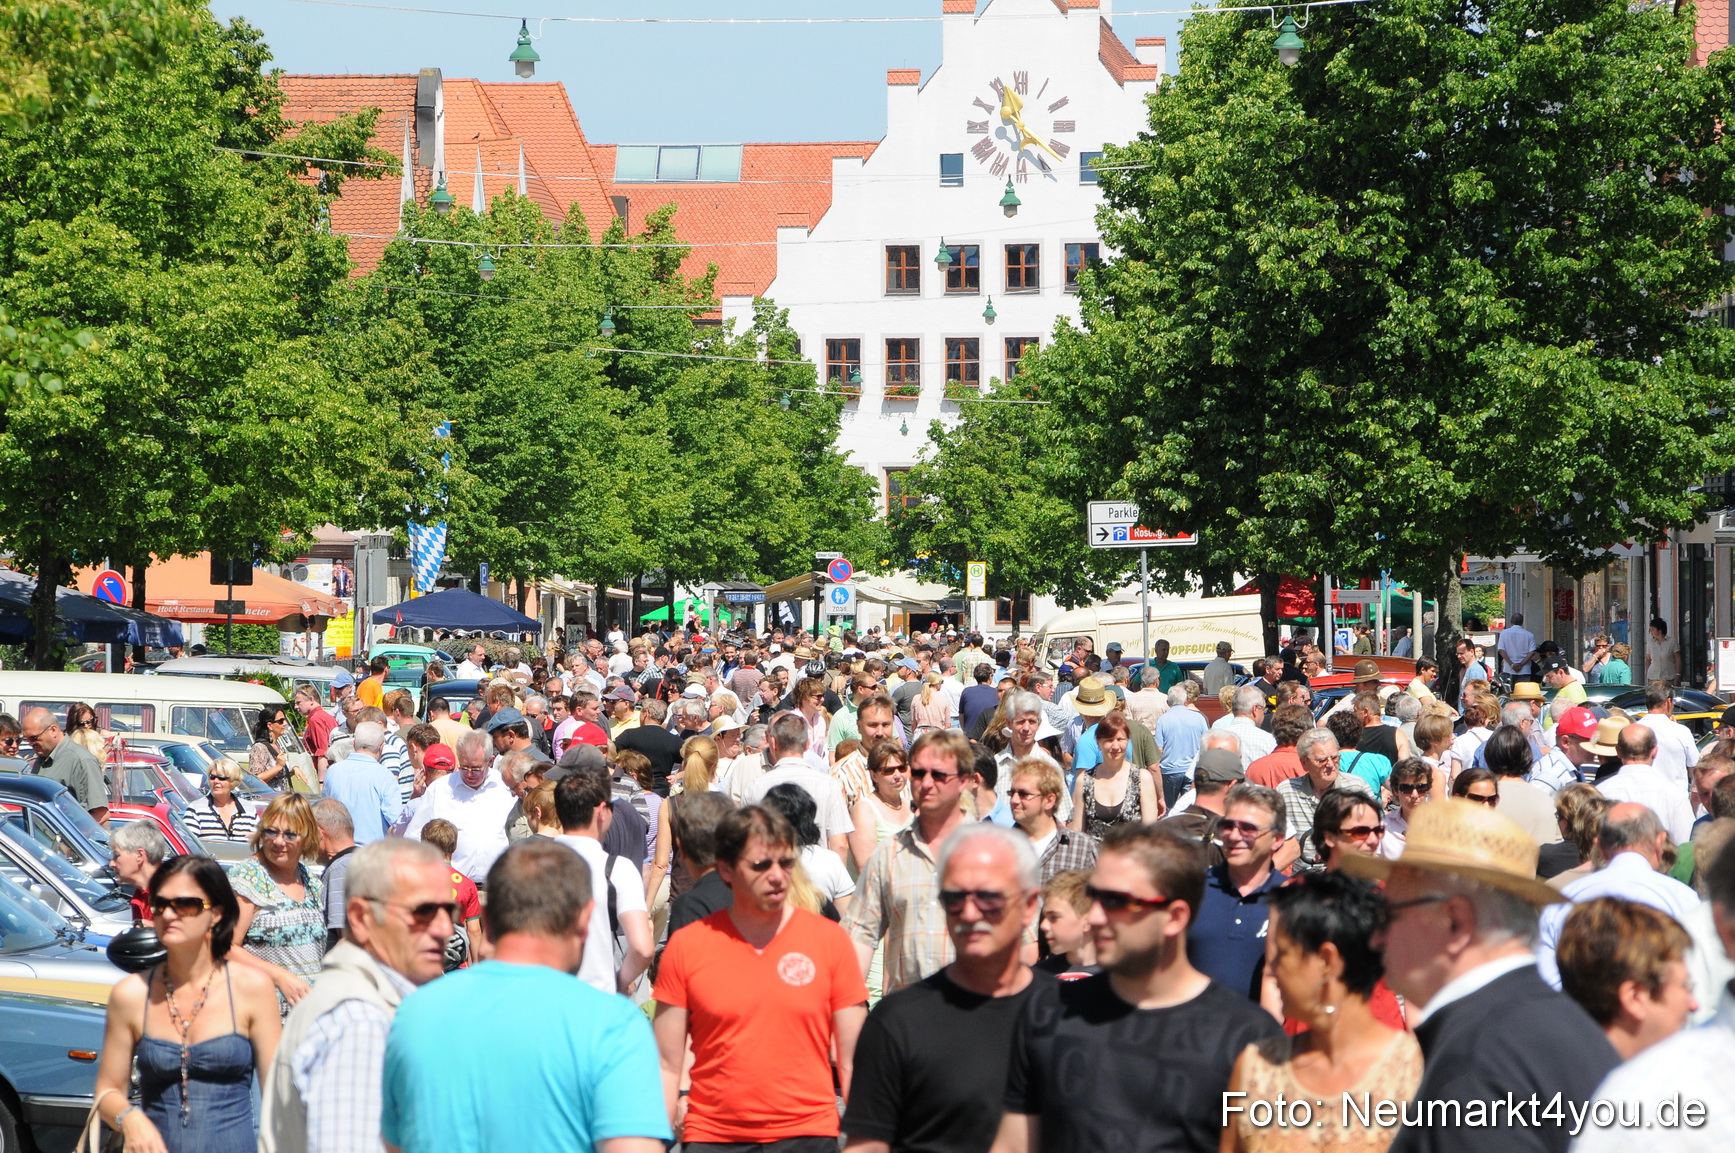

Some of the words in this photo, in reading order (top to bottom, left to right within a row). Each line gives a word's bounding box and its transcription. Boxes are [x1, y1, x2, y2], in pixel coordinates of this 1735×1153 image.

[1108, 507, 1138, 519] Parkle
[157, 605, 178, 613] Hotel
[245, 606, 271, 616] meier
[1120, 629, 1157, 650] Origial
[1169, 642, 1232, 655] OPFGUCK
